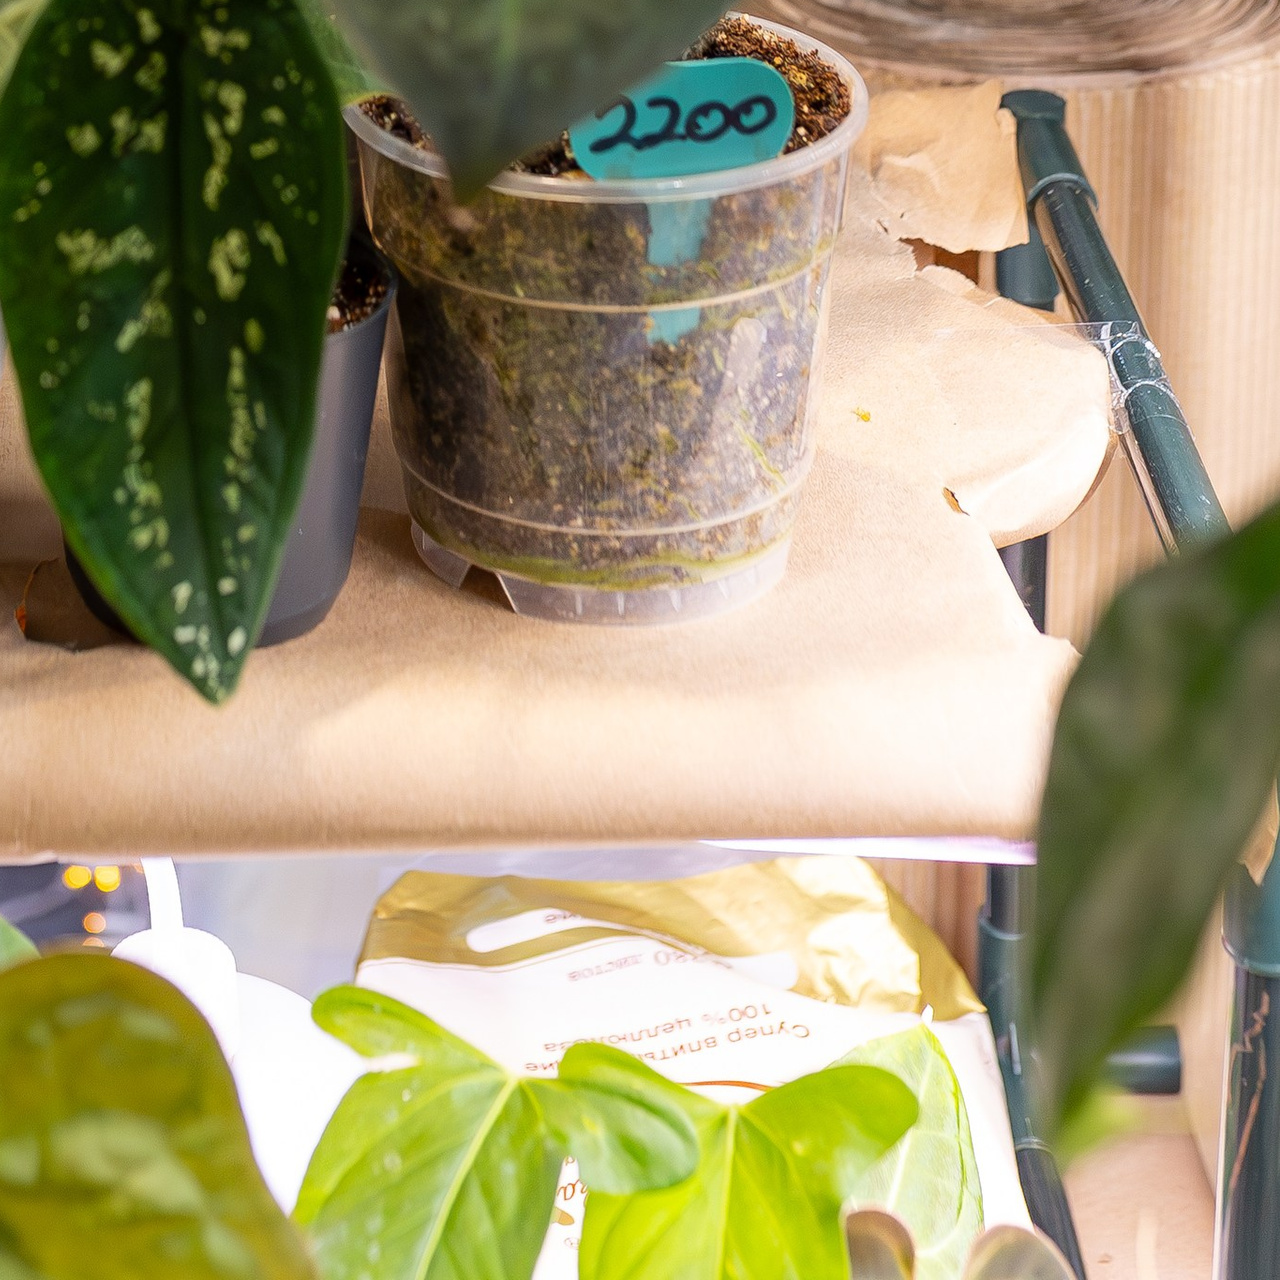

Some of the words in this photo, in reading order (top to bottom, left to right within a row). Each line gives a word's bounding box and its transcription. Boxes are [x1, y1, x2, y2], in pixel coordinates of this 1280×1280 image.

[588, 92, 777, 153] 2200
[701, 1004, 771, 1026] 100%
[727, 1021, 810, 1044] Супер
